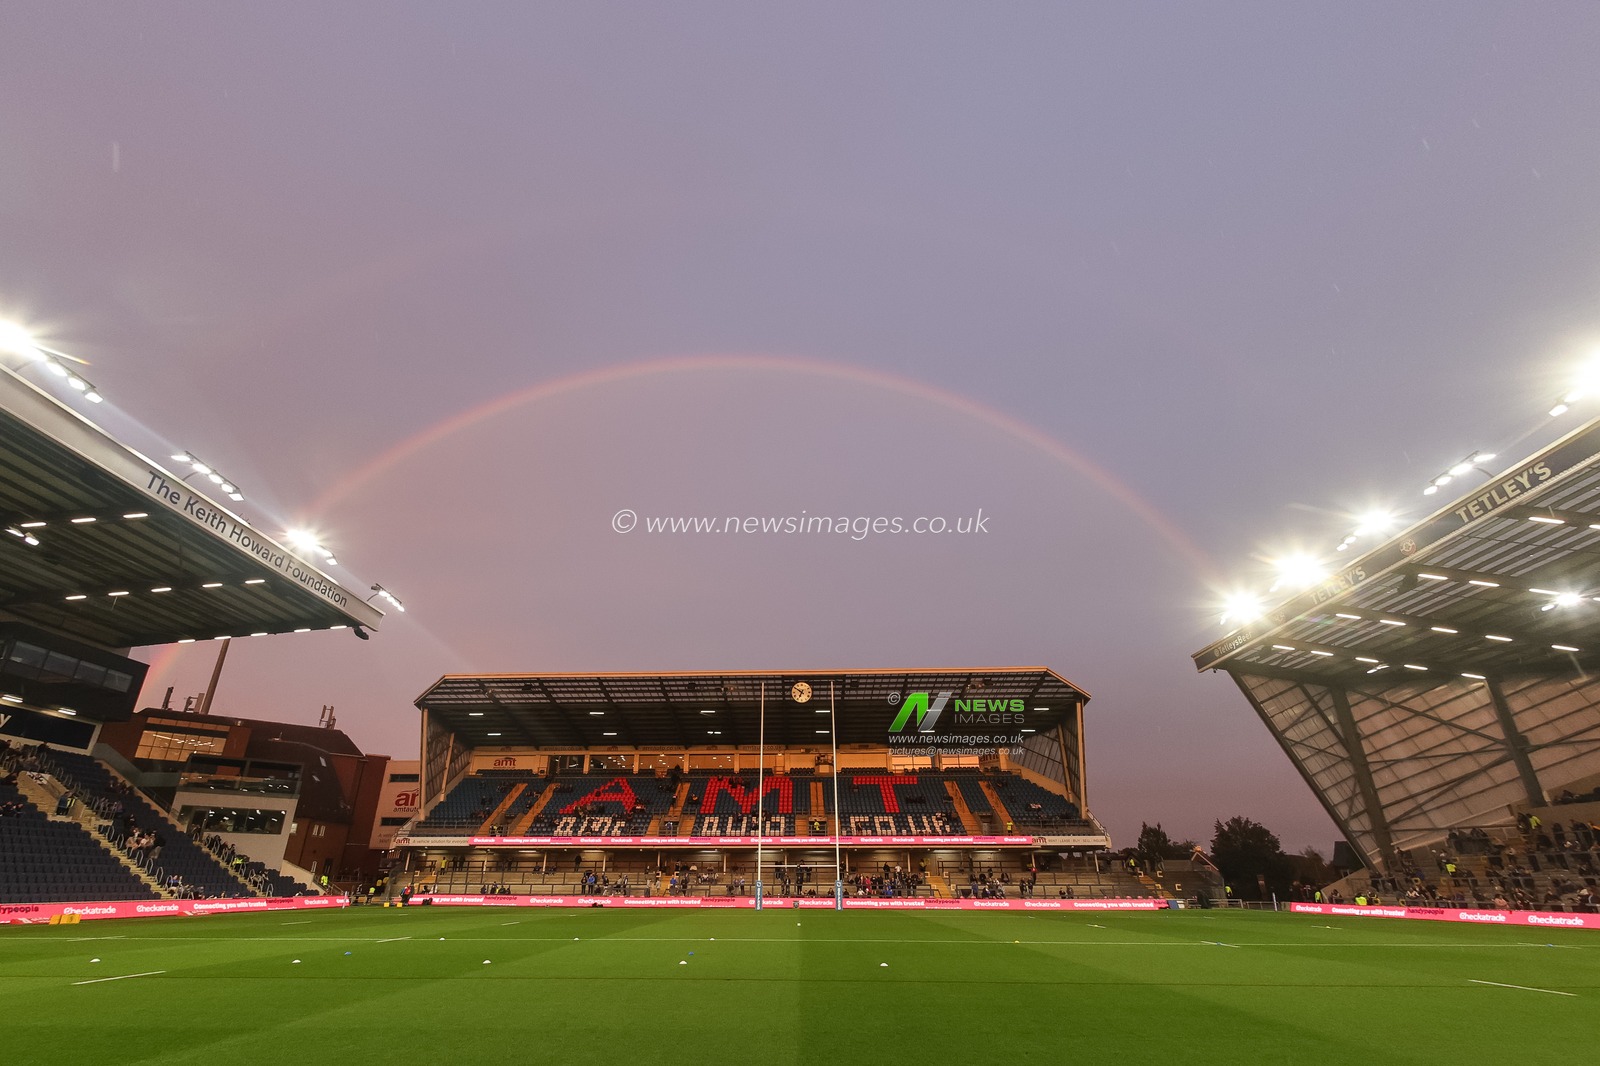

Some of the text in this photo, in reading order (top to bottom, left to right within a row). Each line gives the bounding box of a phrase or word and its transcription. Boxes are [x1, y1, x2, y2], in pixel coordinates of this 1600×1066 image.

[1455, 462, 1552, 523] TETLEY'S
[147, 470, 348, 607] The Keith Howard Foundation
[1309, 566, 1366, 605] TETLEY'S
[493, 757, 517, 767] amt
[64, 906, 116, 915] Checkatrade
[136, 904, 179, 912] Checkatrade
[194, 902, 226, 910] Connecting
[1295, 904, 1322, 913] Checkatrade
[1332, 907, 1359, 915] Connecting
[1407, 907, 1445, 915] handypeople
[1459, 912, 1506, 922] Checkatrade
[1528, 915, 1584, 926] Checkatrade
